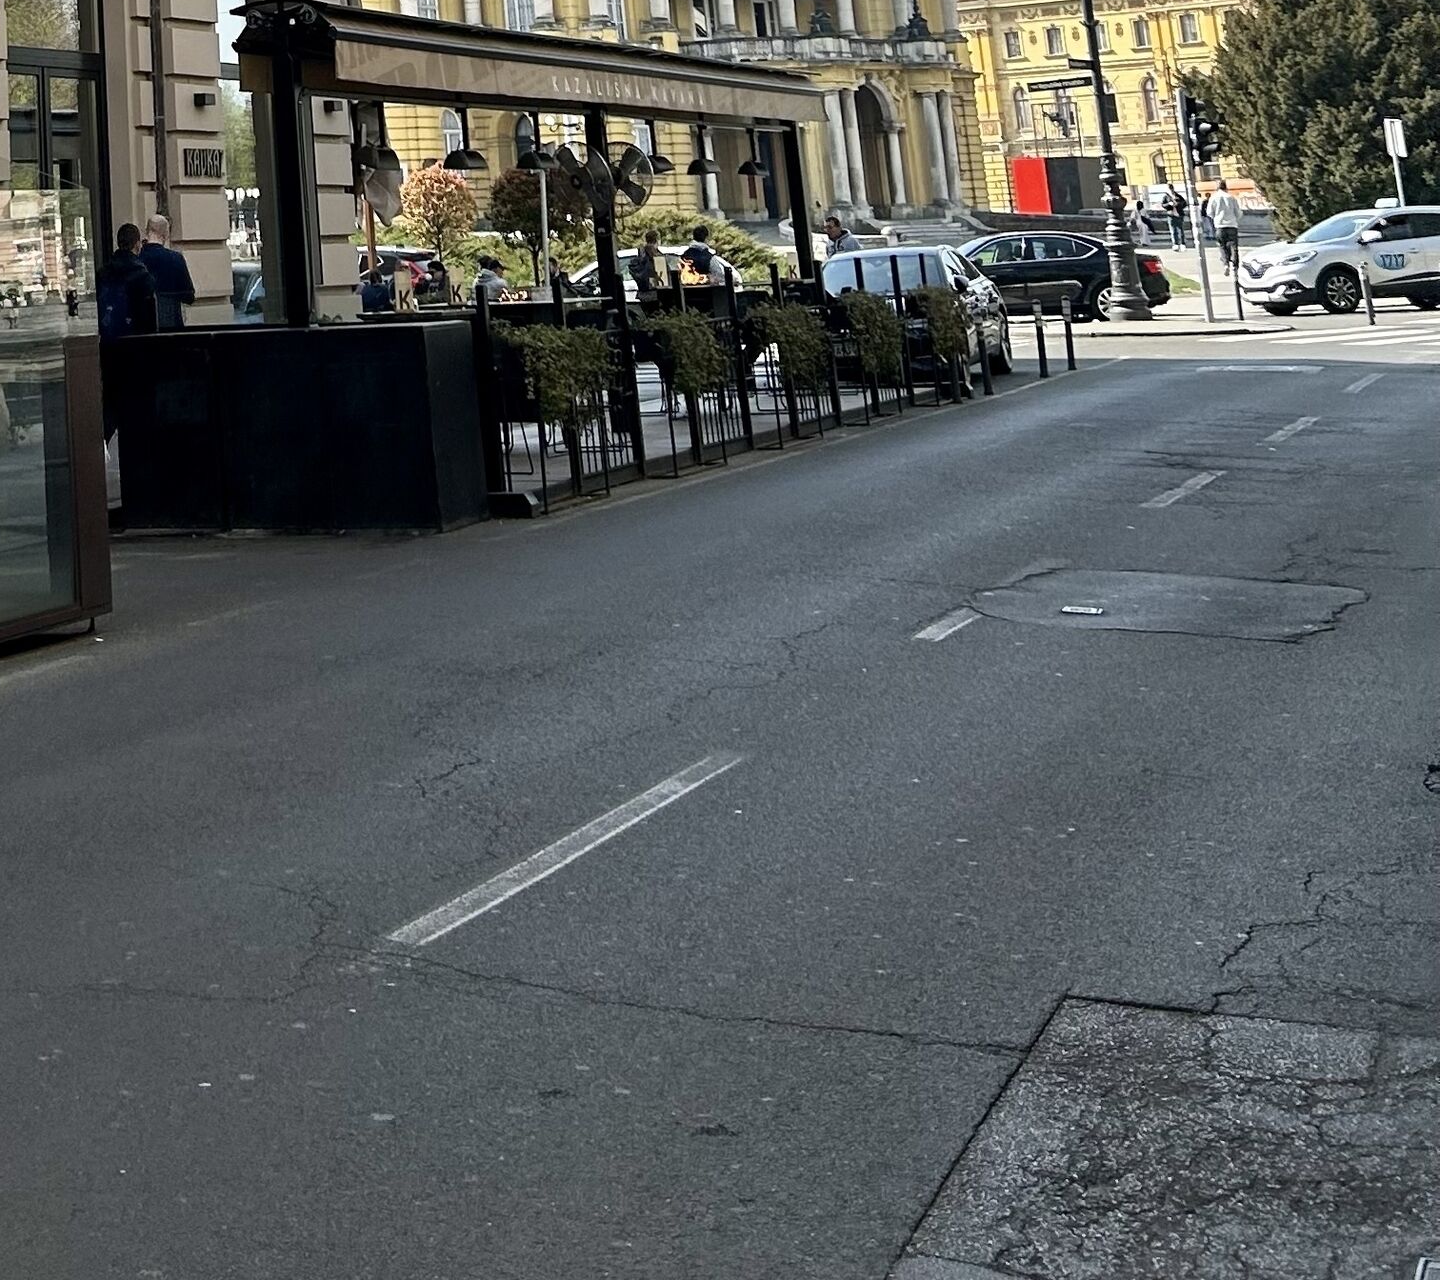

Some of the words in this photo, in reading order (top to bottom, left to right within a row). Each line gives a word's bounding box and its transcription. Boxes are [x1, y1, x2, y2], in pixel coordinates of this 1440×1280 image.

[1380, 254, 1404, 268] 1717
[399, 289, 411, 310] K
[451, 284, 462, 303] K
